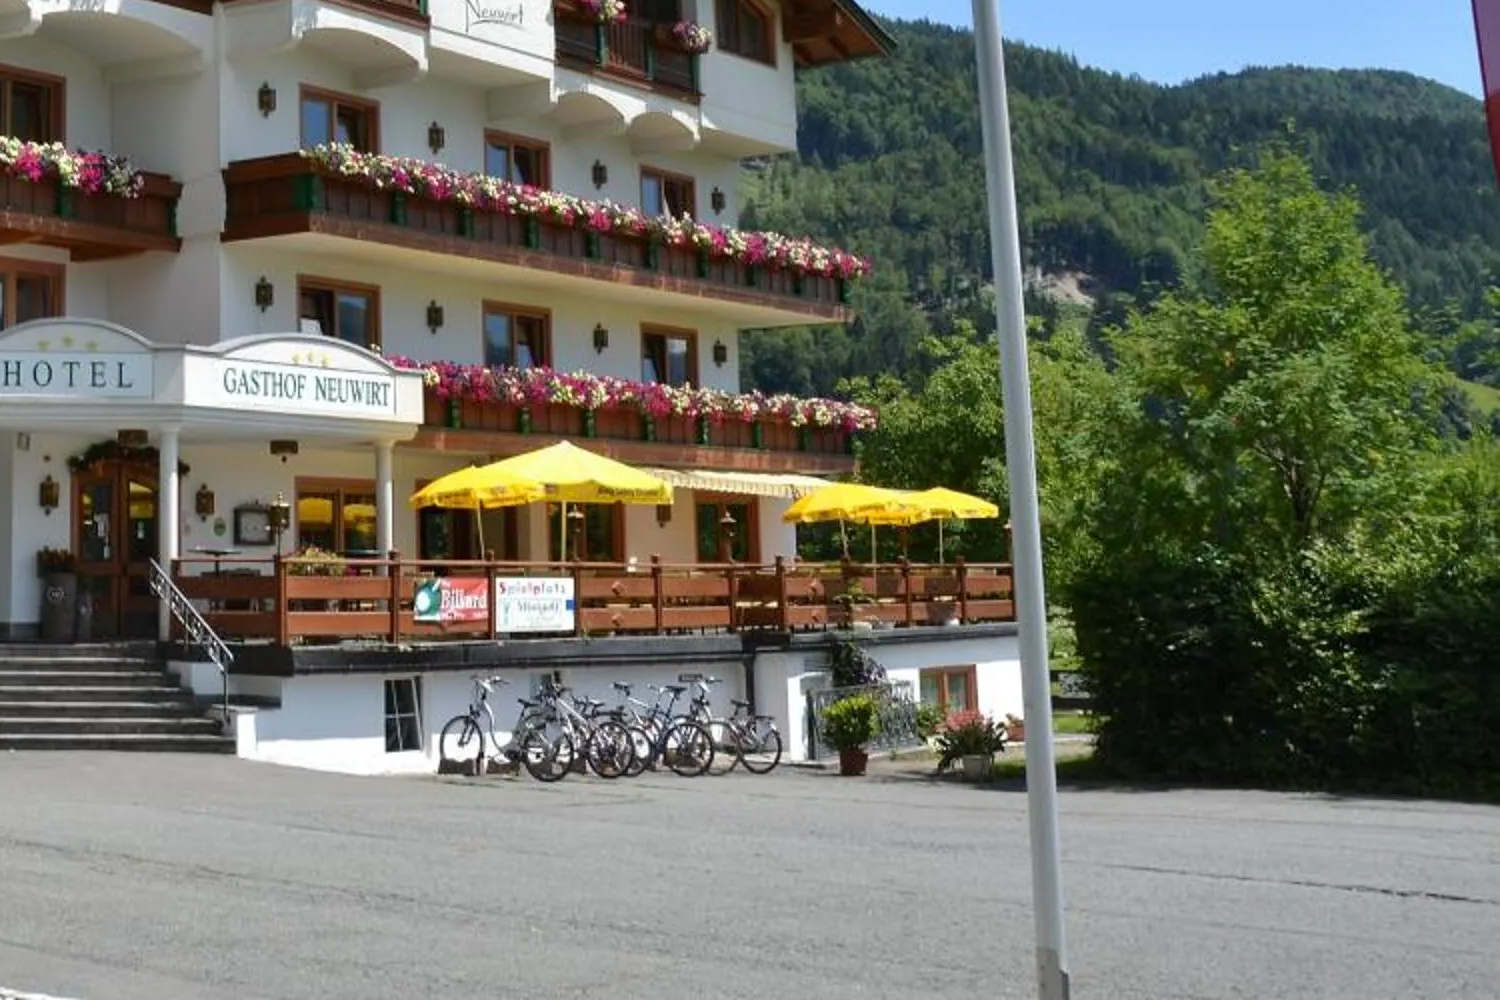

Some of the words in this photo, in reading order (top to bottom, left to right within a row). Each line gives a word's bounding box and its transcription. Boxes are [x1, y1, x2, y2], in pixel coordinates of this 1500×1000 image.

[2, 360, 134, 389] HOTEL
[222, 367, 307, 400] GASTHOF
[315, 376, 392, 408] NEUWIRT
